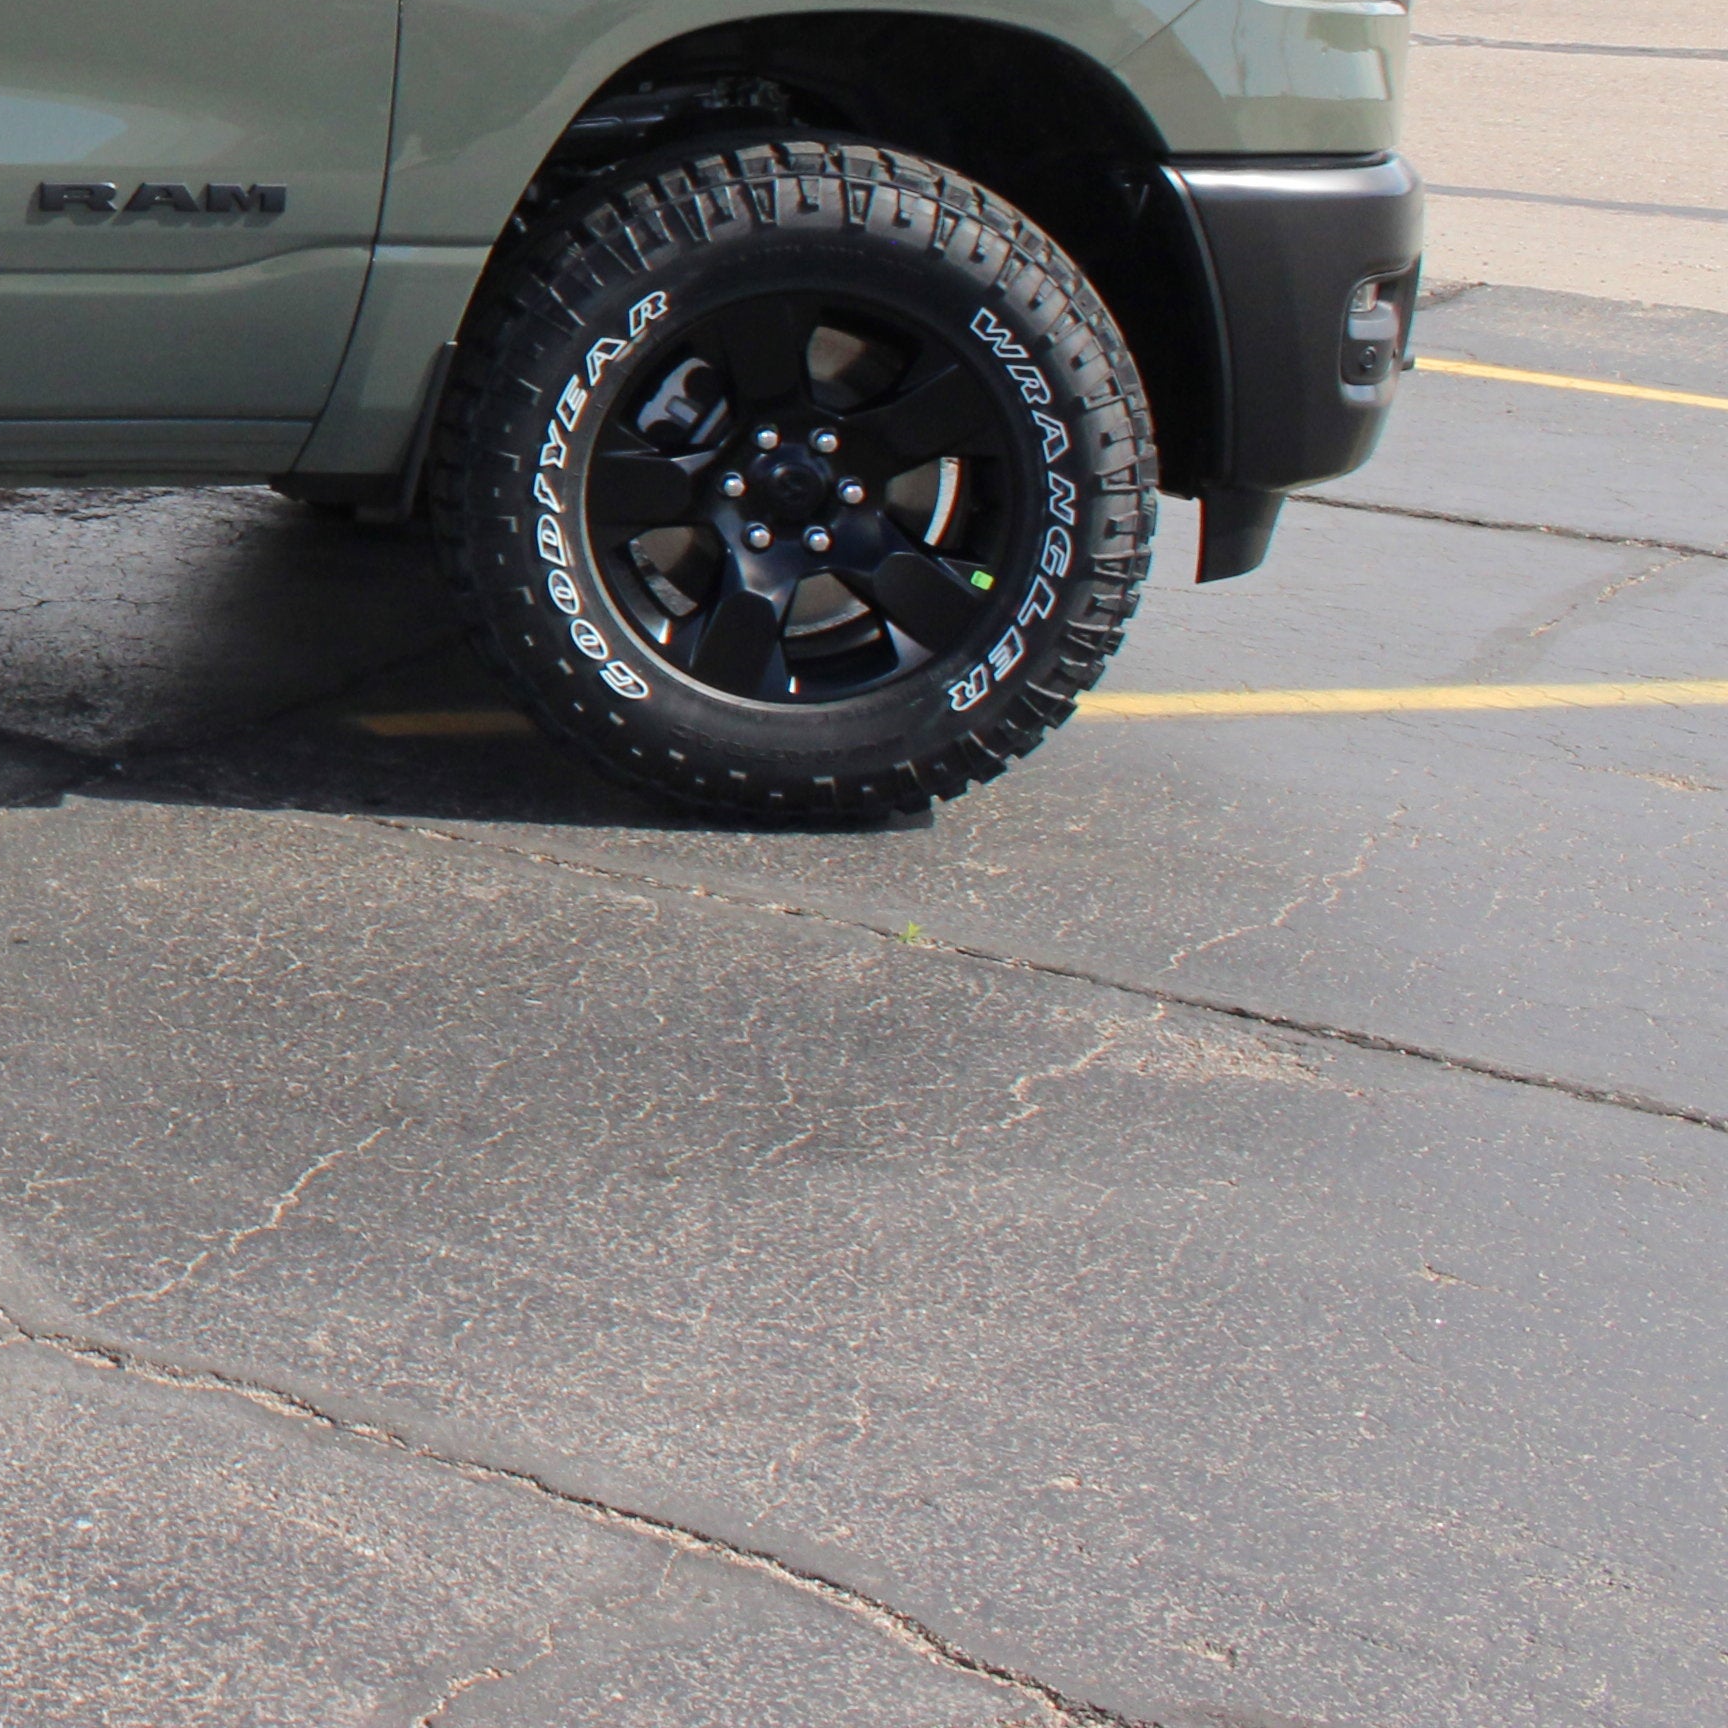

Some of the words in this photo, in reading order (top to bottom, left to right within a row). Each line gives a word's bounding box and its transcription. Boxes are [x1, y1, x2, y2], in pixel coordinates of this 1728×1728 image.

[36, 181, 288, 214] RAM
[533, 290, 670, 700] GOODYEAR
[946, 306, 1080, 713] WRANGLER
